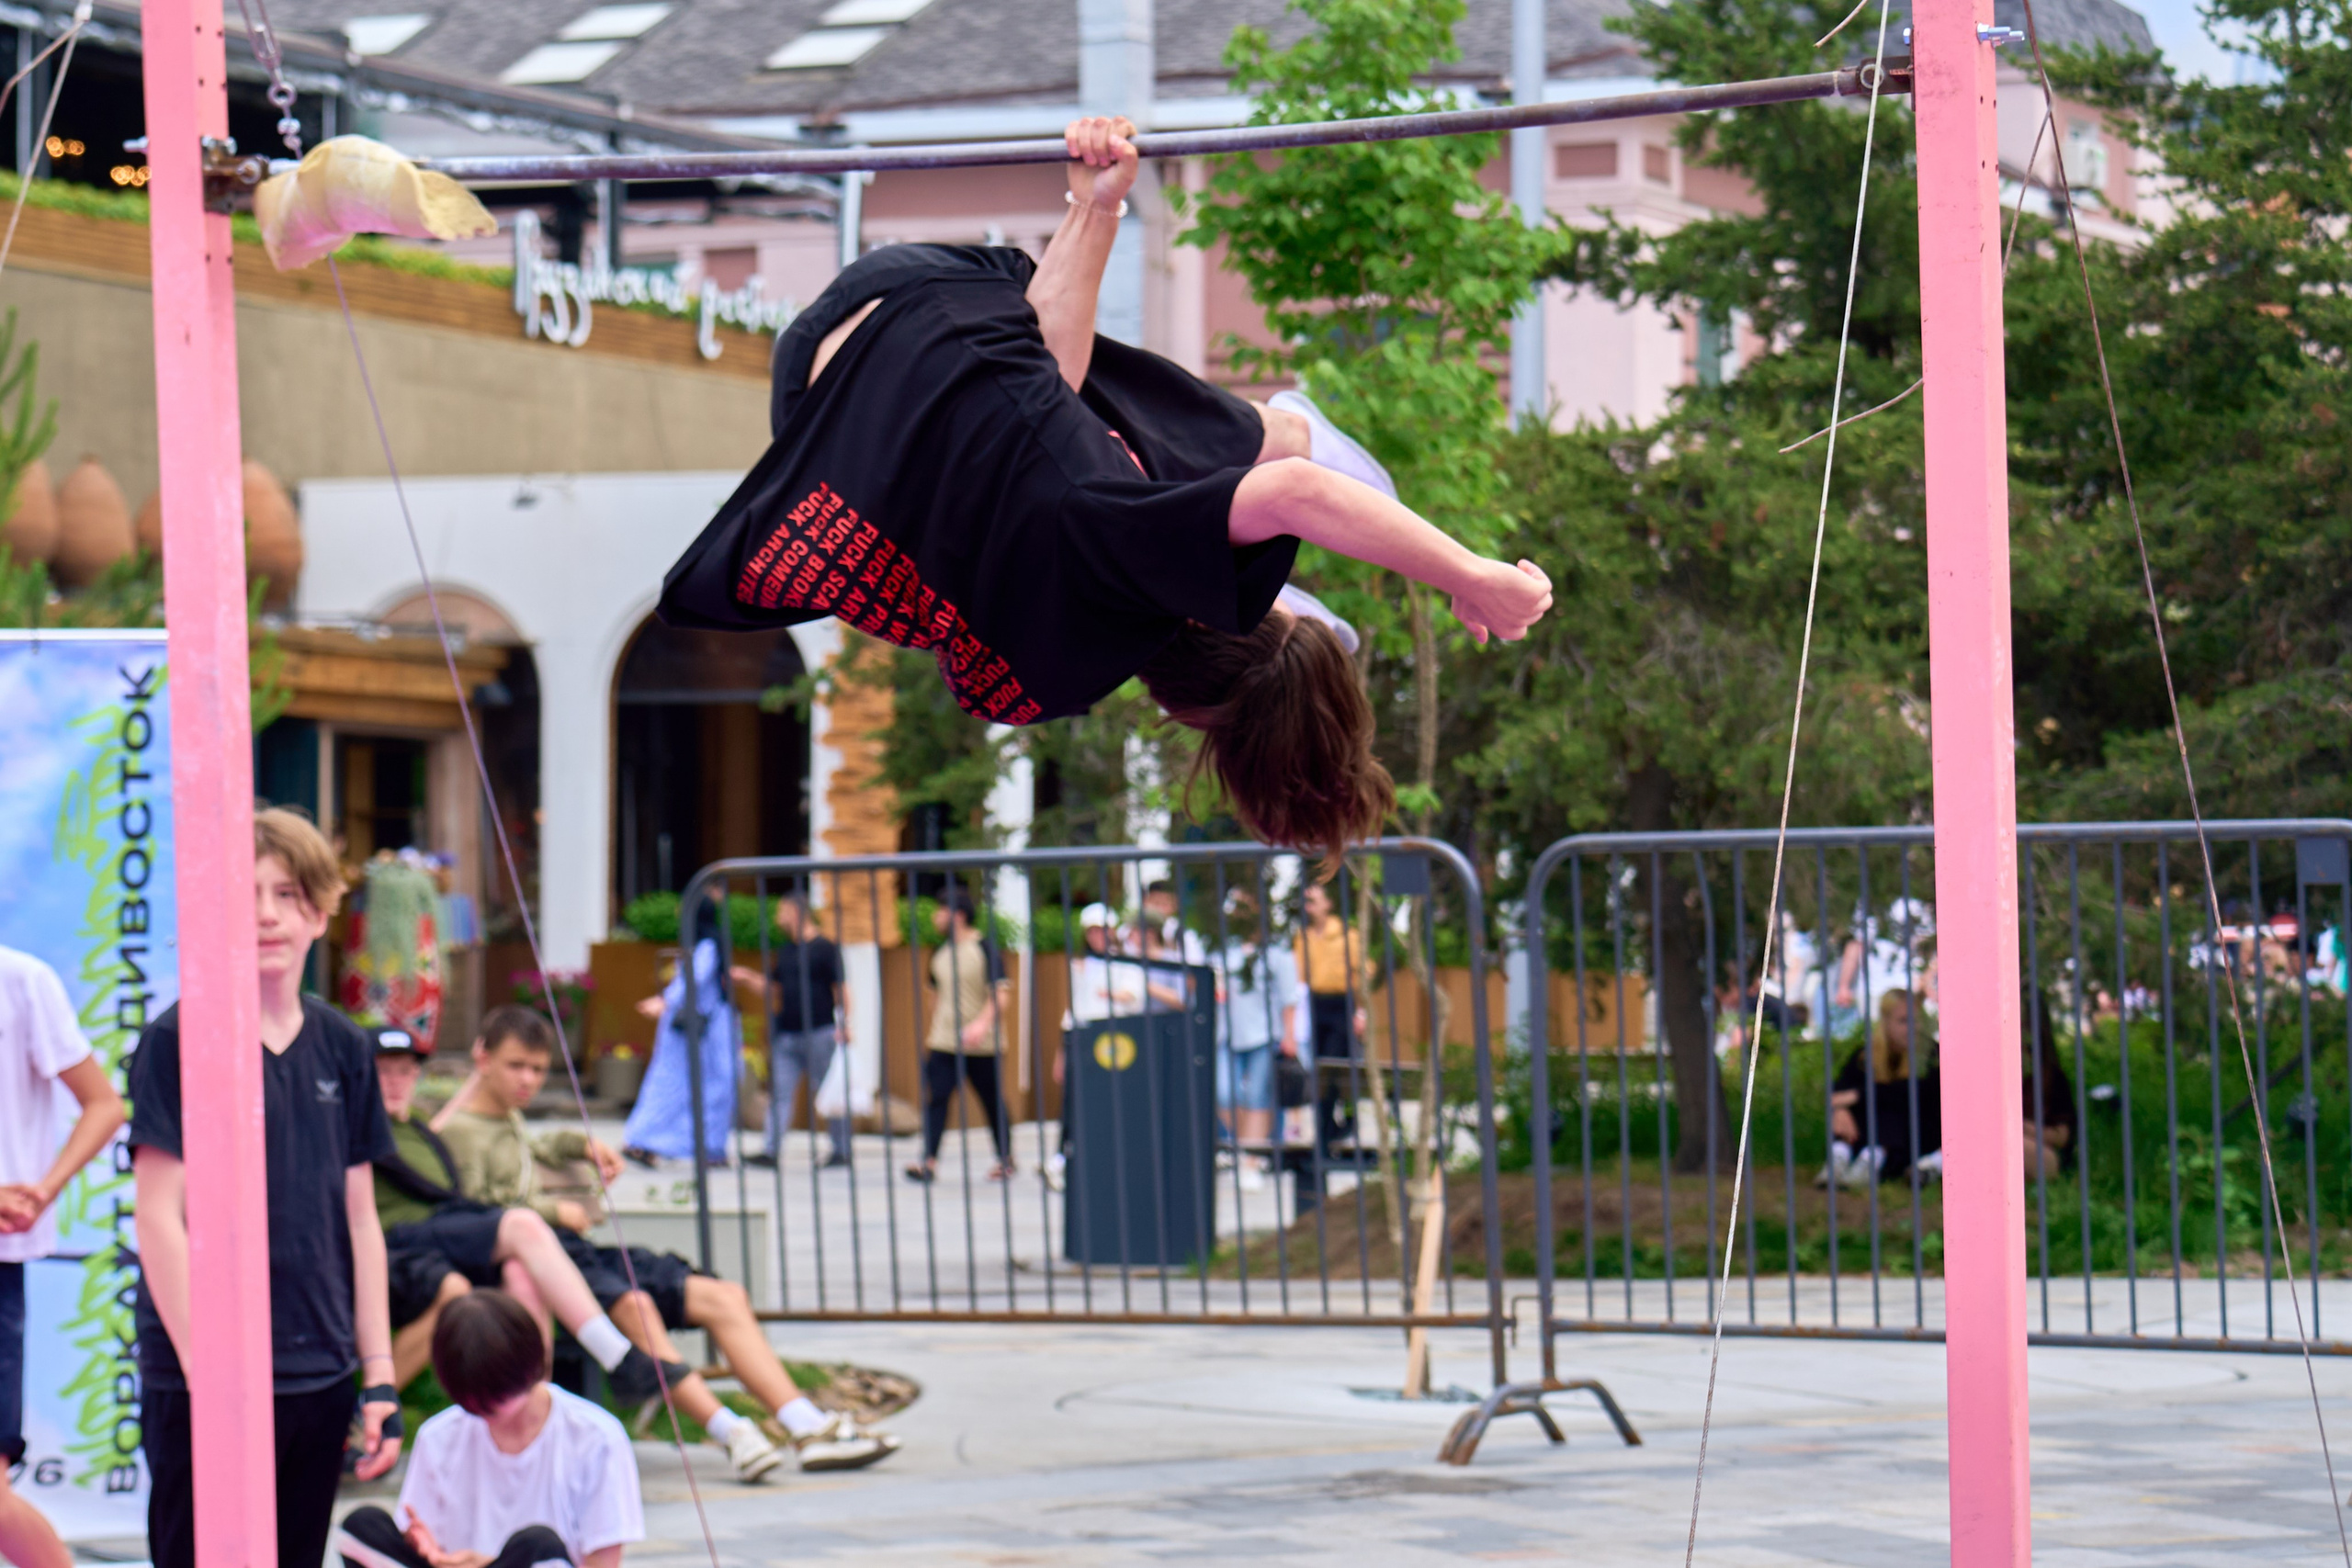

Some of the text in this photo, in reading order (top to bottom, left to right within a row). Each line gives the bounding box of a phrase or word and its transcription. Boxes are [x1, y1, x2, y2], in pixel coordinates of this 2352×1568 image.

[786, 480, 830, 527] FUCK
[804, 491, 844, 542] FUCK
[818, 507, 860, 557] FUCK
[837, 520, 879, 573] FUCK
[859, 537, 897, 590] FUCK
[878, 553, 916, 605] FUCK
[982, 675, 1023, 717] FUCK
[114, 664, 155, 1175] ВАДИВОСТОК
